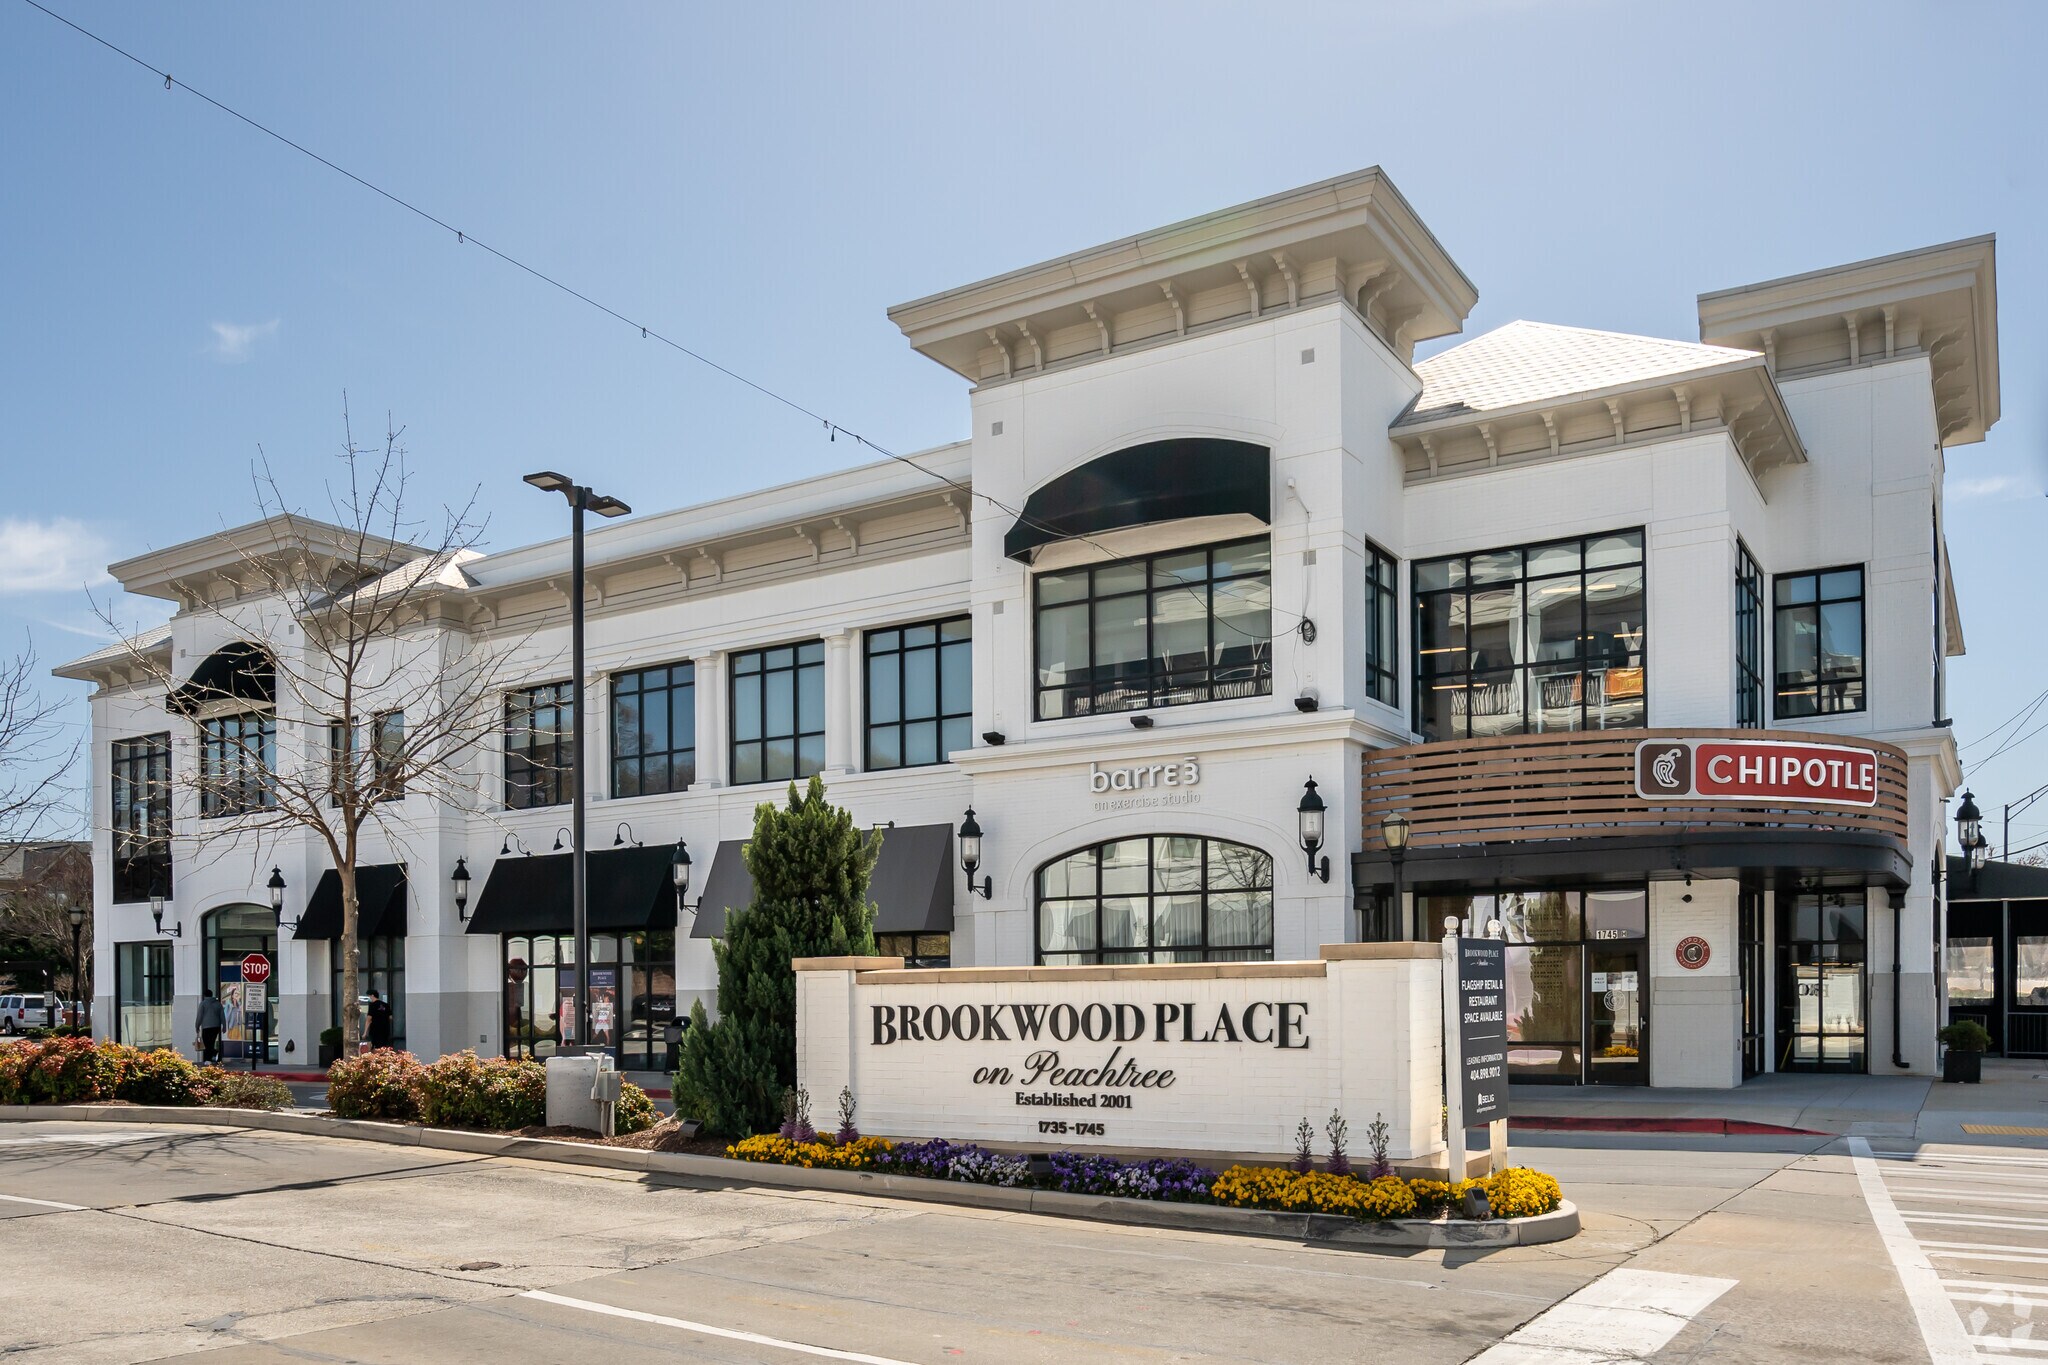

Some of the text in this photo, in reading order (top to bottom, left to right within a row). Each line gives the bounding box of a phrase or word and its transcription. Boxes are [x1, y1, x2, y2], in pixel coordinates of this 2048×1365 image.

[1707, 754, 1874, 791] CHIPOTLE
[1093, 790, 1201, 811] an exercise studio
[1597, 930, 1617, 939] 1745
[1678, 937, 1709, 951] CHIPOTLE
[1464, 948, 1499, 958] BROOKWOOD PLACE
[243, 962, 269, 975] STOP
[1461, 979, 1504, 991] FLAGSHIP RETAIL &
[1468, 995, 1498, 1007] RESTAURANT
[1464, 1010, 1503, 1023] SPACE AVAILABLE
[870, 1002, 1310, 1050] BROOKWOOD PLACE
[1466, 1053, 1503, 1066] LEASING INFORMATION
[972, 1046, 1177, 1089] on Peachtree
[1470, 1066, 1501, 1081] 404.898.9012
[1014, 1091, 1133, 1109] Established 2001
[1482, 1093, 1495, 1104] SELIG
[1038, 1120, 1105, 1136] 1735-1745
